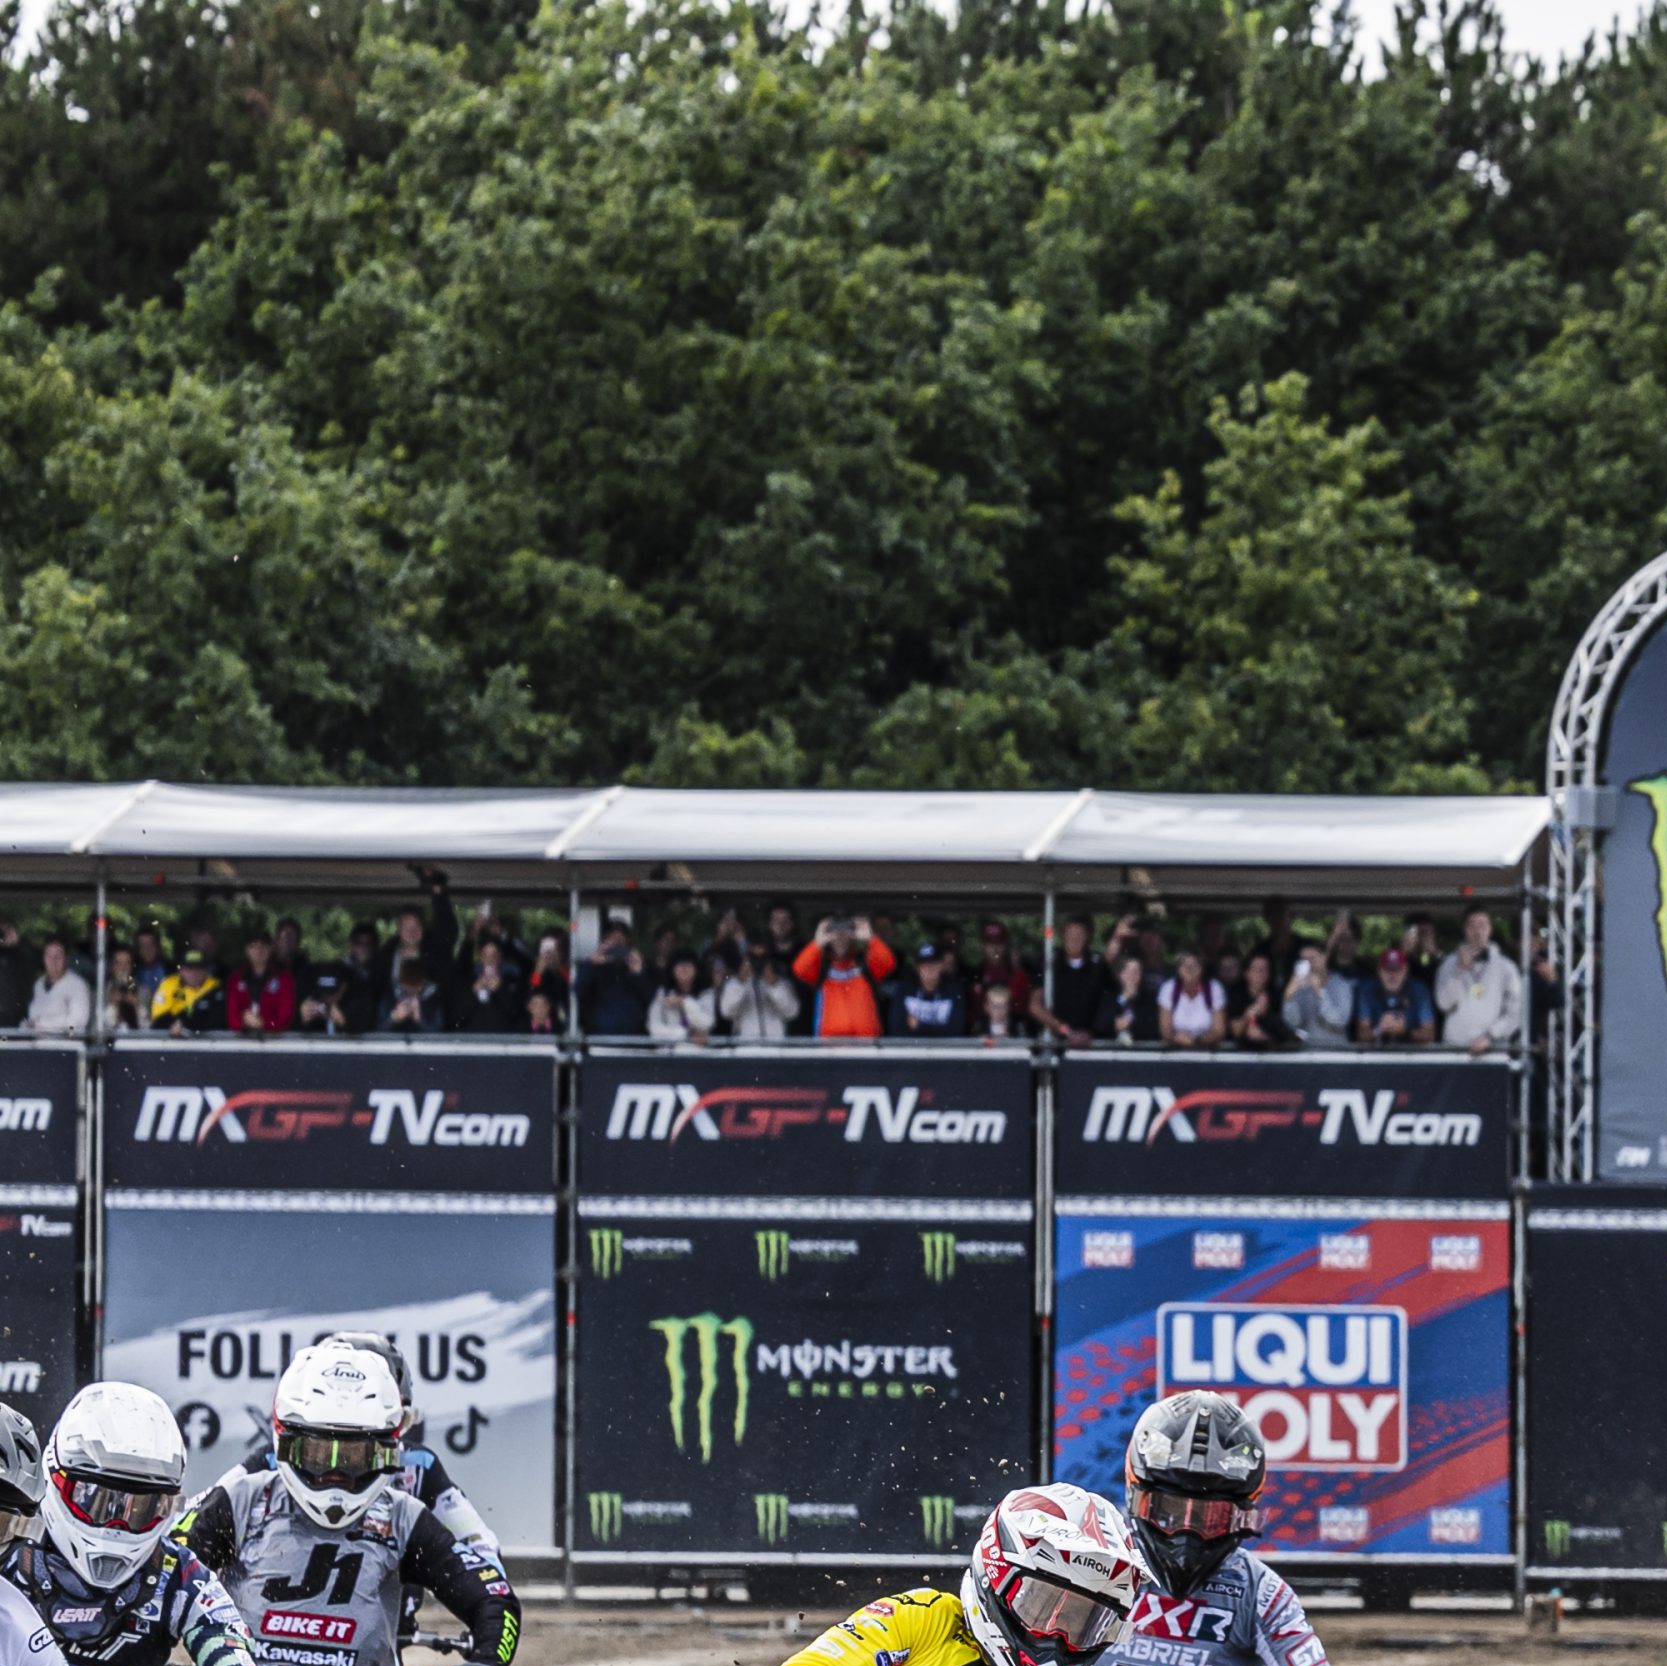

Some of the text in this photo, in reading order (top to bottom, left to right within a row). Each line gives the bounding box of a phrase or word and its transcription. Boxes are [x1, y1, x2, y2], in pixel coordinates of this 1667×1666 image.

[417, 1333, 487, 1383] US
[757, 1338, 957, 1378] MONSTER
[1172, 1313, 1391, 1387] LIQUI
[1243, 1389, 1398, 1462] OLY
[1072, 1554, 1111, 1578] AIROH
[1204, 1583, 1244, 1598] AIROH
[266, 1614, 353, 1640] BIKE IT
